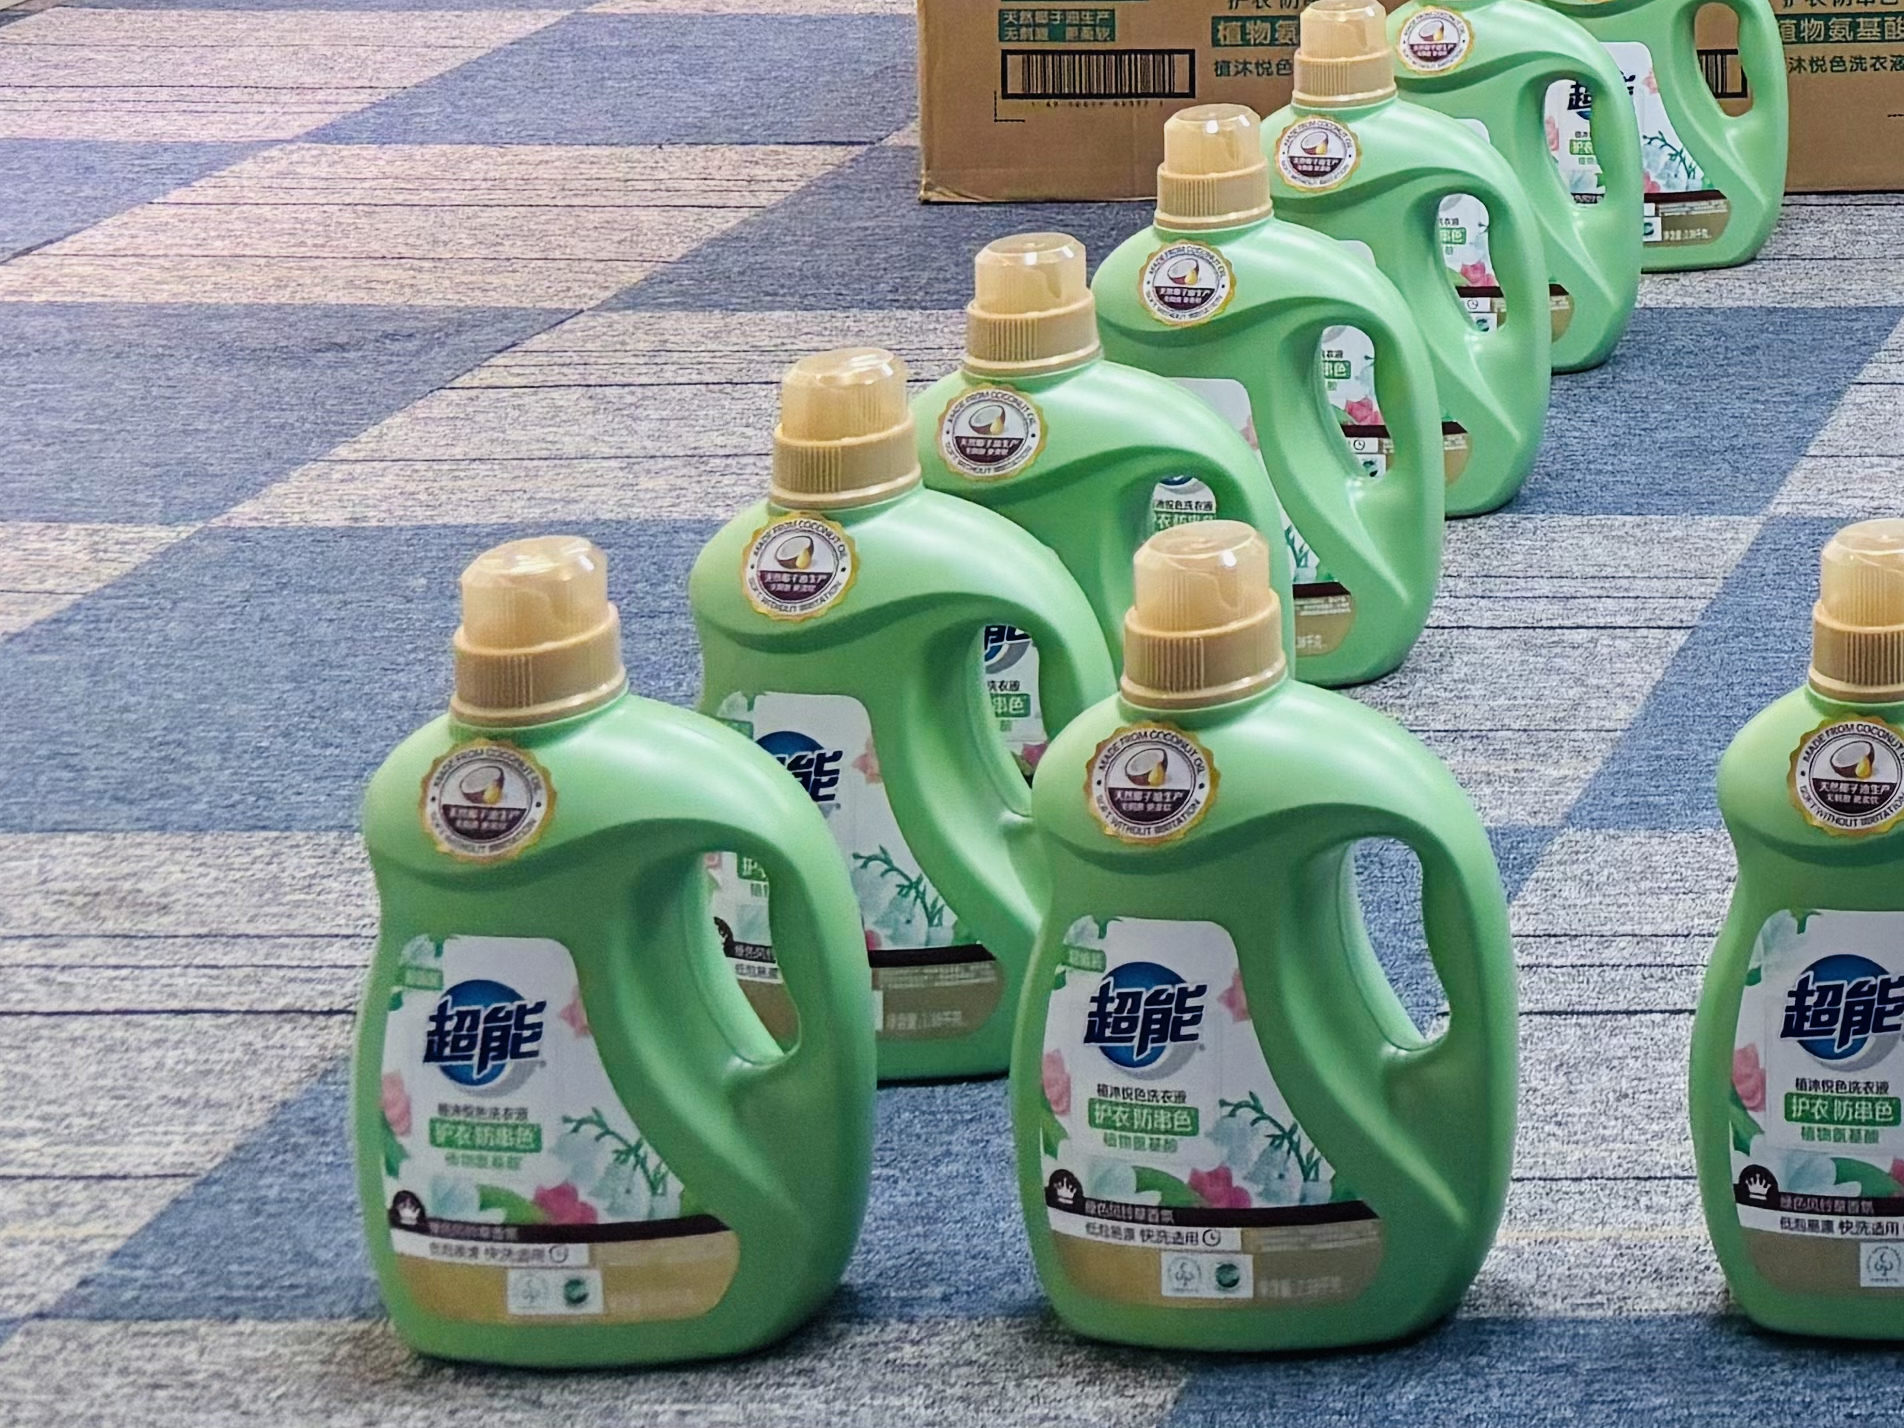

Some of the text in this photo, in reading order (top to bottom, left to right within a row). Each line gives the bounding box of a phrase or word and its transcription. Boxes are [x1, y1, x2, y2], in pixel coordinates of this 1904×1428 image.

[1803, 724, 1904, 762] MADE FROM COCONUT
[1816, 808, 1858, 827] WITHOUT
[1791, 1097, 1893, 1122] 护衣 防串色
[1838, 1220, 1899, 1236] 快洗适用
